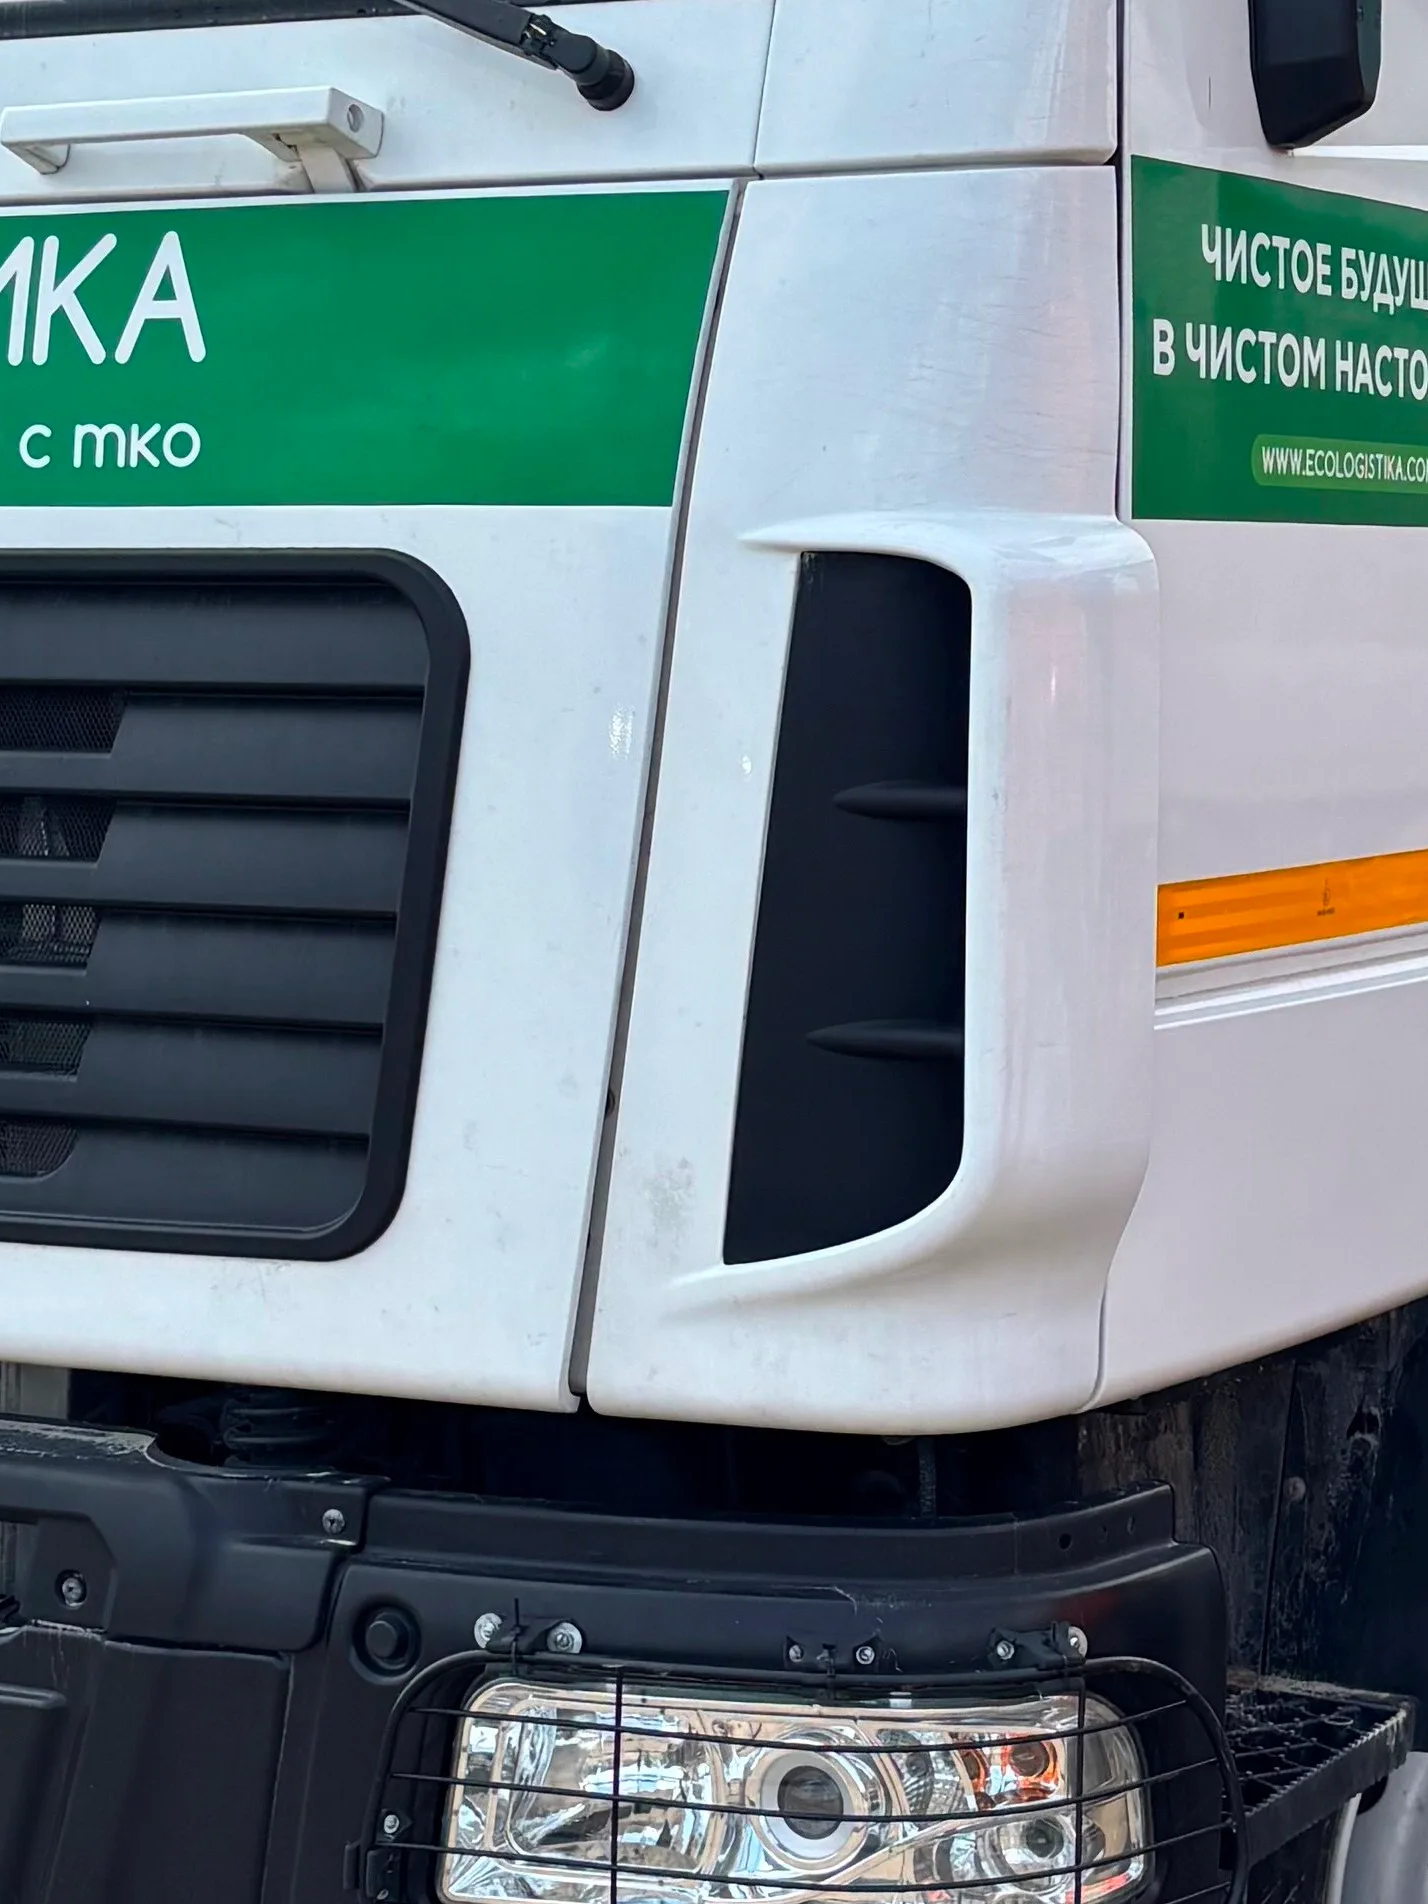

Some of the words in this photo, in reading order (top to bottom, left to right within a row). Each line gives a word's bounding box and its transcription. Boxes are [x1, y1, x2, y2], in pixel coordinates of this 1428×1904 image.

[1200, 223, 1332, 296] ЧИСТОЕ
[1153, 318, 1176, 376] В
[1185, 322, 1326, 390] ЧИСТОМ
[19, 424, 52, 469] с
[73, 422, 201, 468] тко
